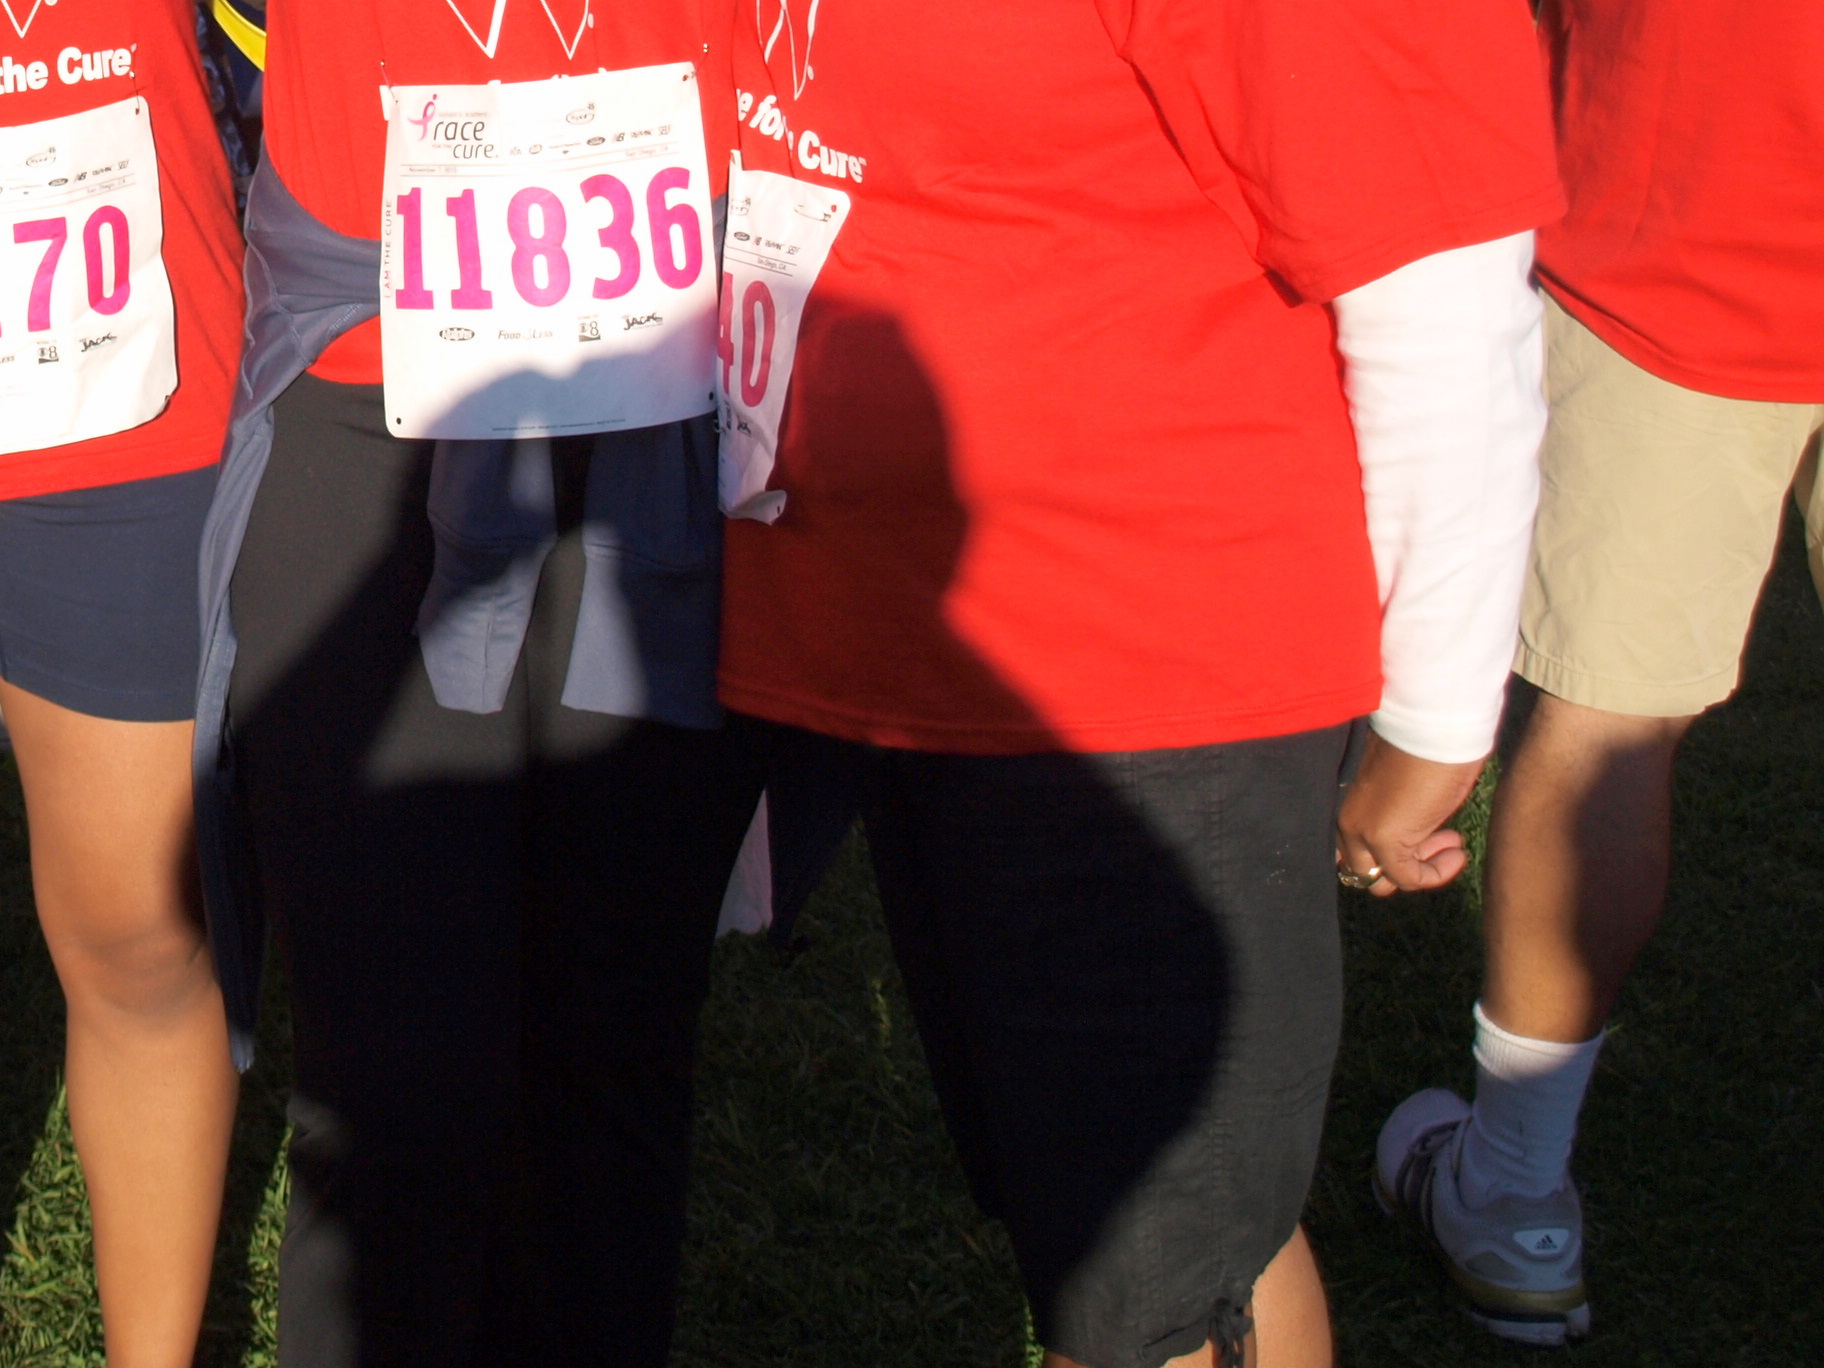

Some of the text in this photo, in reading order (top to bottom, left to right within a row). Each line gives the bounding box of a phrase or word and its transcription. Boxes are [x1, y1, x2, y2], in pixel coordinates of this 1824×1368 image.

[57, 46, 132, 85] Cure
[433, 119, 485, 142] race
[797, 129, 863, 184] Cure
[385, 200, 393, 236] CURE
[384, 241, 392, 266] THE
[395, 167, 703, 311] 11836
[384, 270, 392, 289] AM
